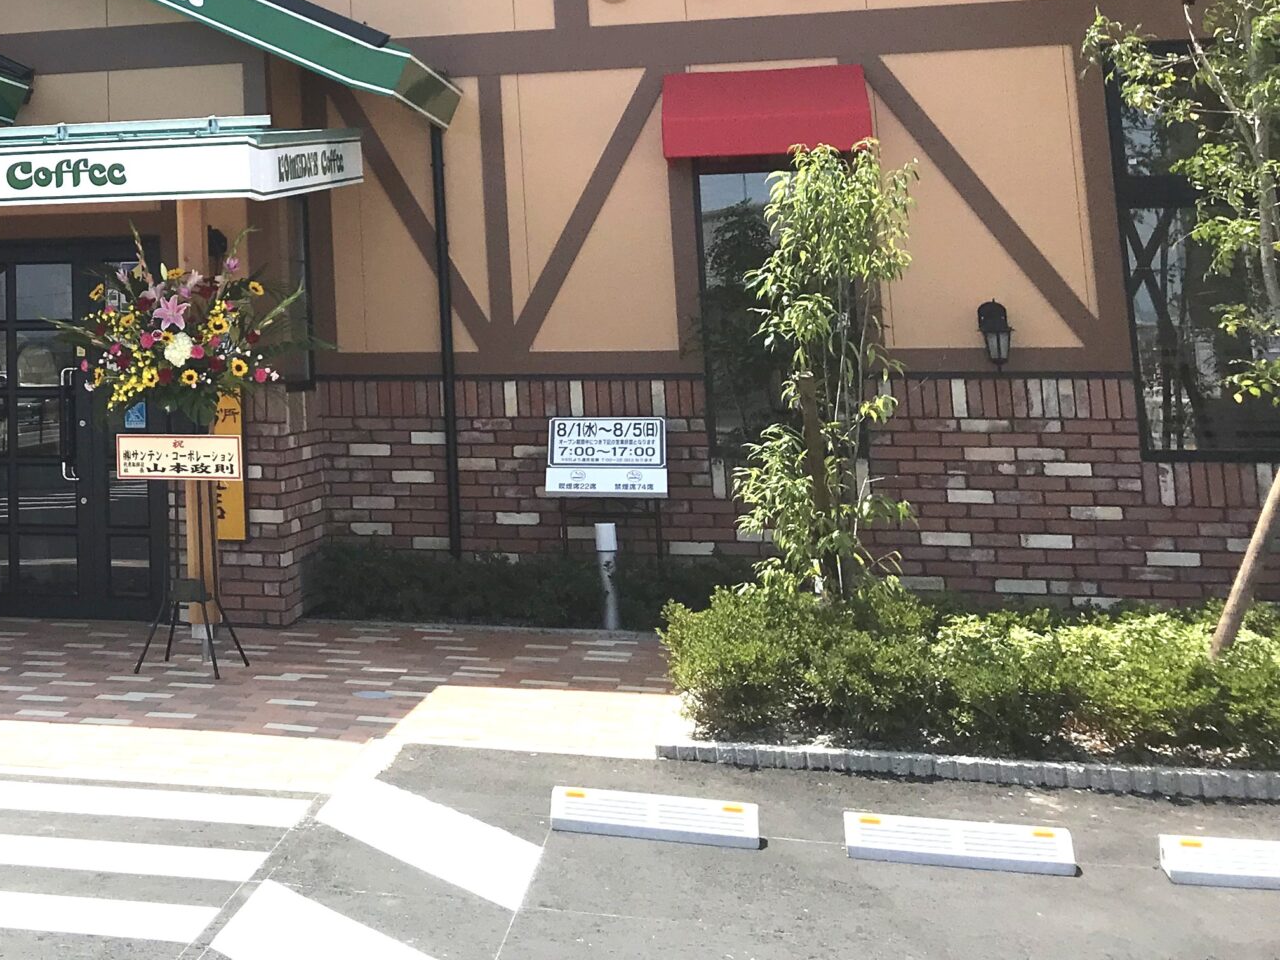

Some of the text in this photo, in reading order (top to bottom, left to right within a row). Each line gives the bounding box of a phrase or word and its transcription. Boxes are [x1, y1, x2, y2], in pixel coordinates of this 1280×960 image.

[6, 158, 127, 188] Coffee
[278, 148, 344, 183] KOMEDA'S Coffee
[146, 463, 234, 474] 山本政則
